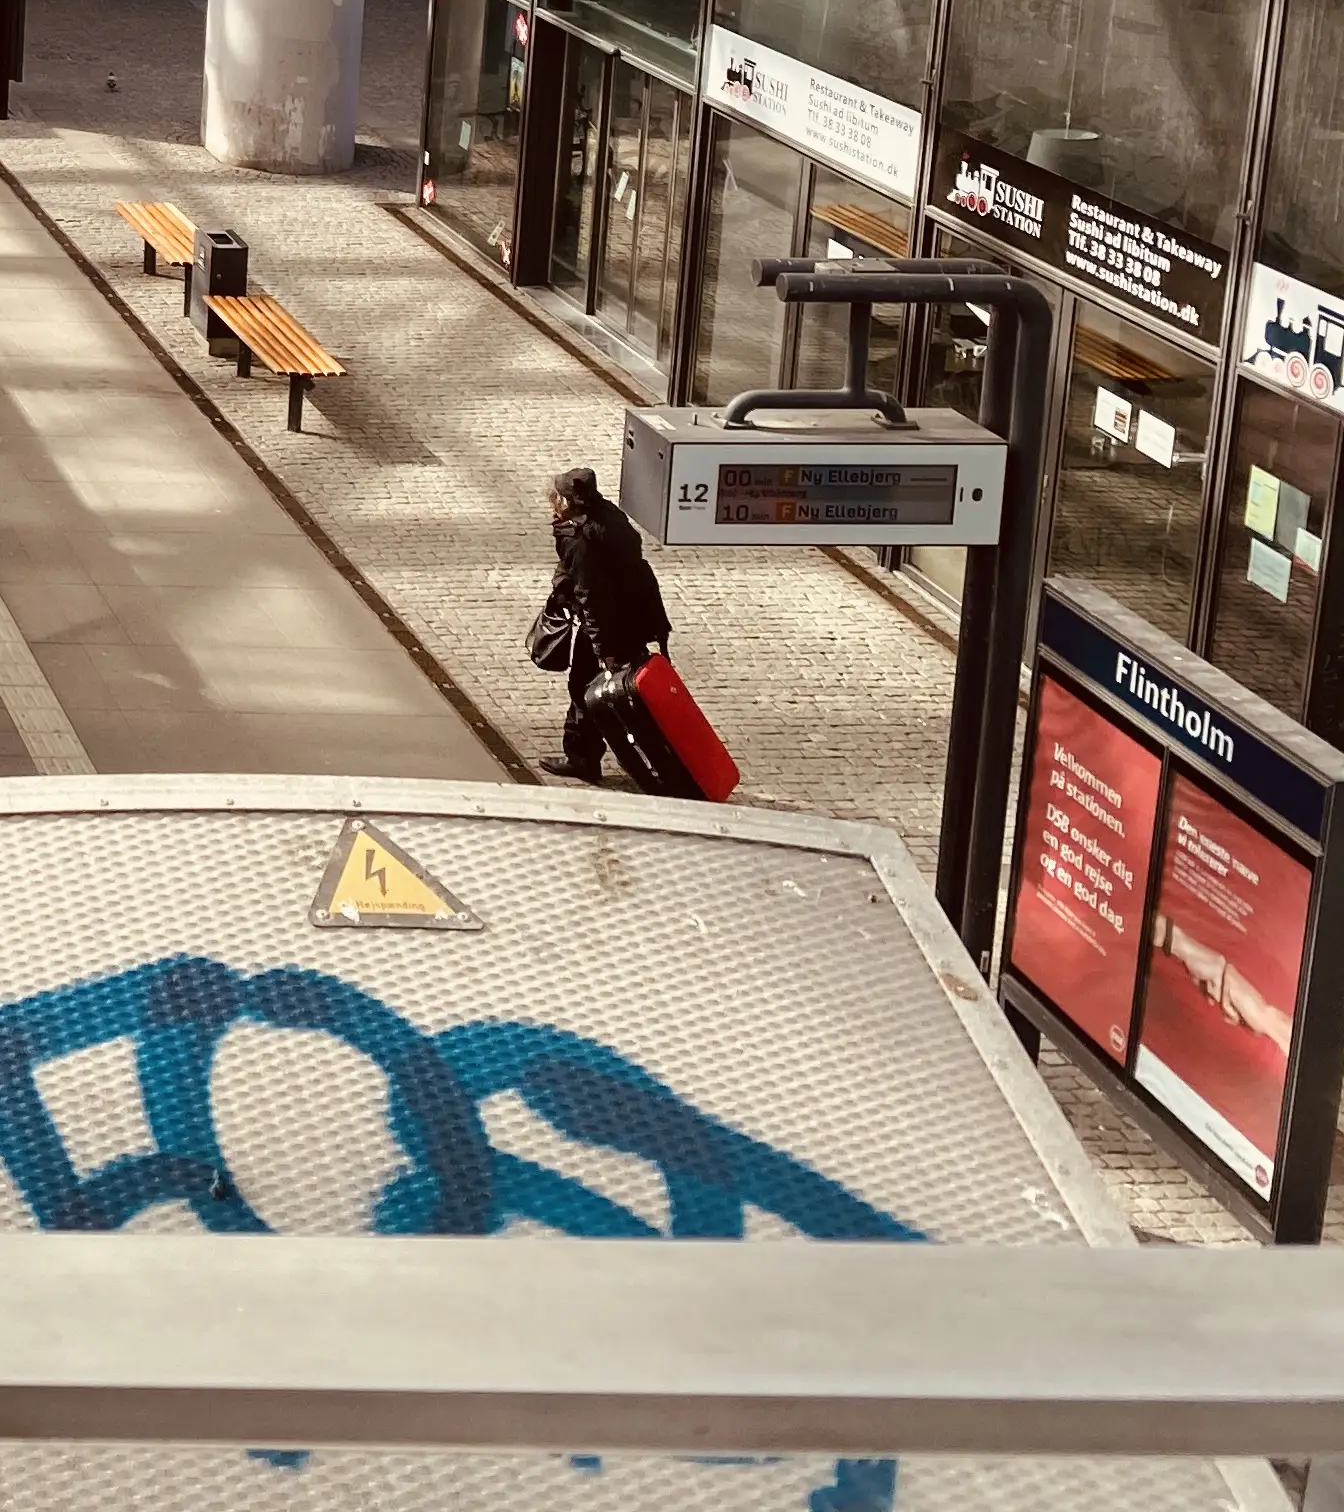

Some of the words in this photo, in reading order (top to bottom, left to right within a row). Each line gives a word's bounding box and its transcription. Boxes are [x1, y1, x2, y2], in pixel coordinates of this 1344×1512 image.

[752, 92, 788, 117] STATION
[755, 70, 789, 103] SUSHI
[808, 93, 832, 114] Sushi
[833, 104, 844, 119] ad
[845, 110, 879, 136] libitum
[810, 77, 859, 109] Restaurant
[859, 99, 868, 113] &
[869, 103, 915, 137] Takeaway
[823, 115, 834, 130] 38
[848, 126, 859, 143] 38
[860, 132, 872, 149] 08
[992, 204, 1042, 239] STATION
[995, 180, 1045, 222] SUSHI
[1068, 229, 1087, 254] Tlf.
[1090, 240, 1106, 262] 38
[1107, 247, 1124, 269] 33
[1125, 256, 1142, 278] 38
[1143, 265, 1161, 288] 08
[1069, 212, 1104, 240] Sushi
[1104, 229, 1122, 250] ad
[1122, 235, 1172, 274] libitum
[1072, 194, 1141, 239] Restaurant
[1141, 226, 1155, 246] &
[1156, 231, 1223, 280] Takeaway
[1065, 249, 1201, 327] www.sushistation.dk
[678, 483, 710, 504] 12
[723, 469, 752, 487] 00
[783, 470, 795, 484] F
[800, 469, 822, 487] Ny
[828, 468, 902, 487] Ellebjerg
[722, 504, 750, 523] 10
[781, 506, 793, 519] F
[797, 504, 820, 522] Ny
[825, 504, 899, 523] Ellebjerg
[1115, 651, 1235, 763] Flintholm
[1050, 769, 1066, 792] på
[1066, 782, 1126, 839] stationen.
[1053, 741, 1123, 809] Velkommen
[1042, 829, 1059, 852] en
[1060, 842, 1084, 872] god
[1085, 862, 1114, 897] rejse
[1046, 802, 1070, 835] DSB
[1112, 861, 1133, 891] dig
[355, 899, 426, 912] Højspænding
[1039, 852, 1057, 879] og
[1056, 866, 1073, 889] en
[1073, 879, 1098, 910] god
